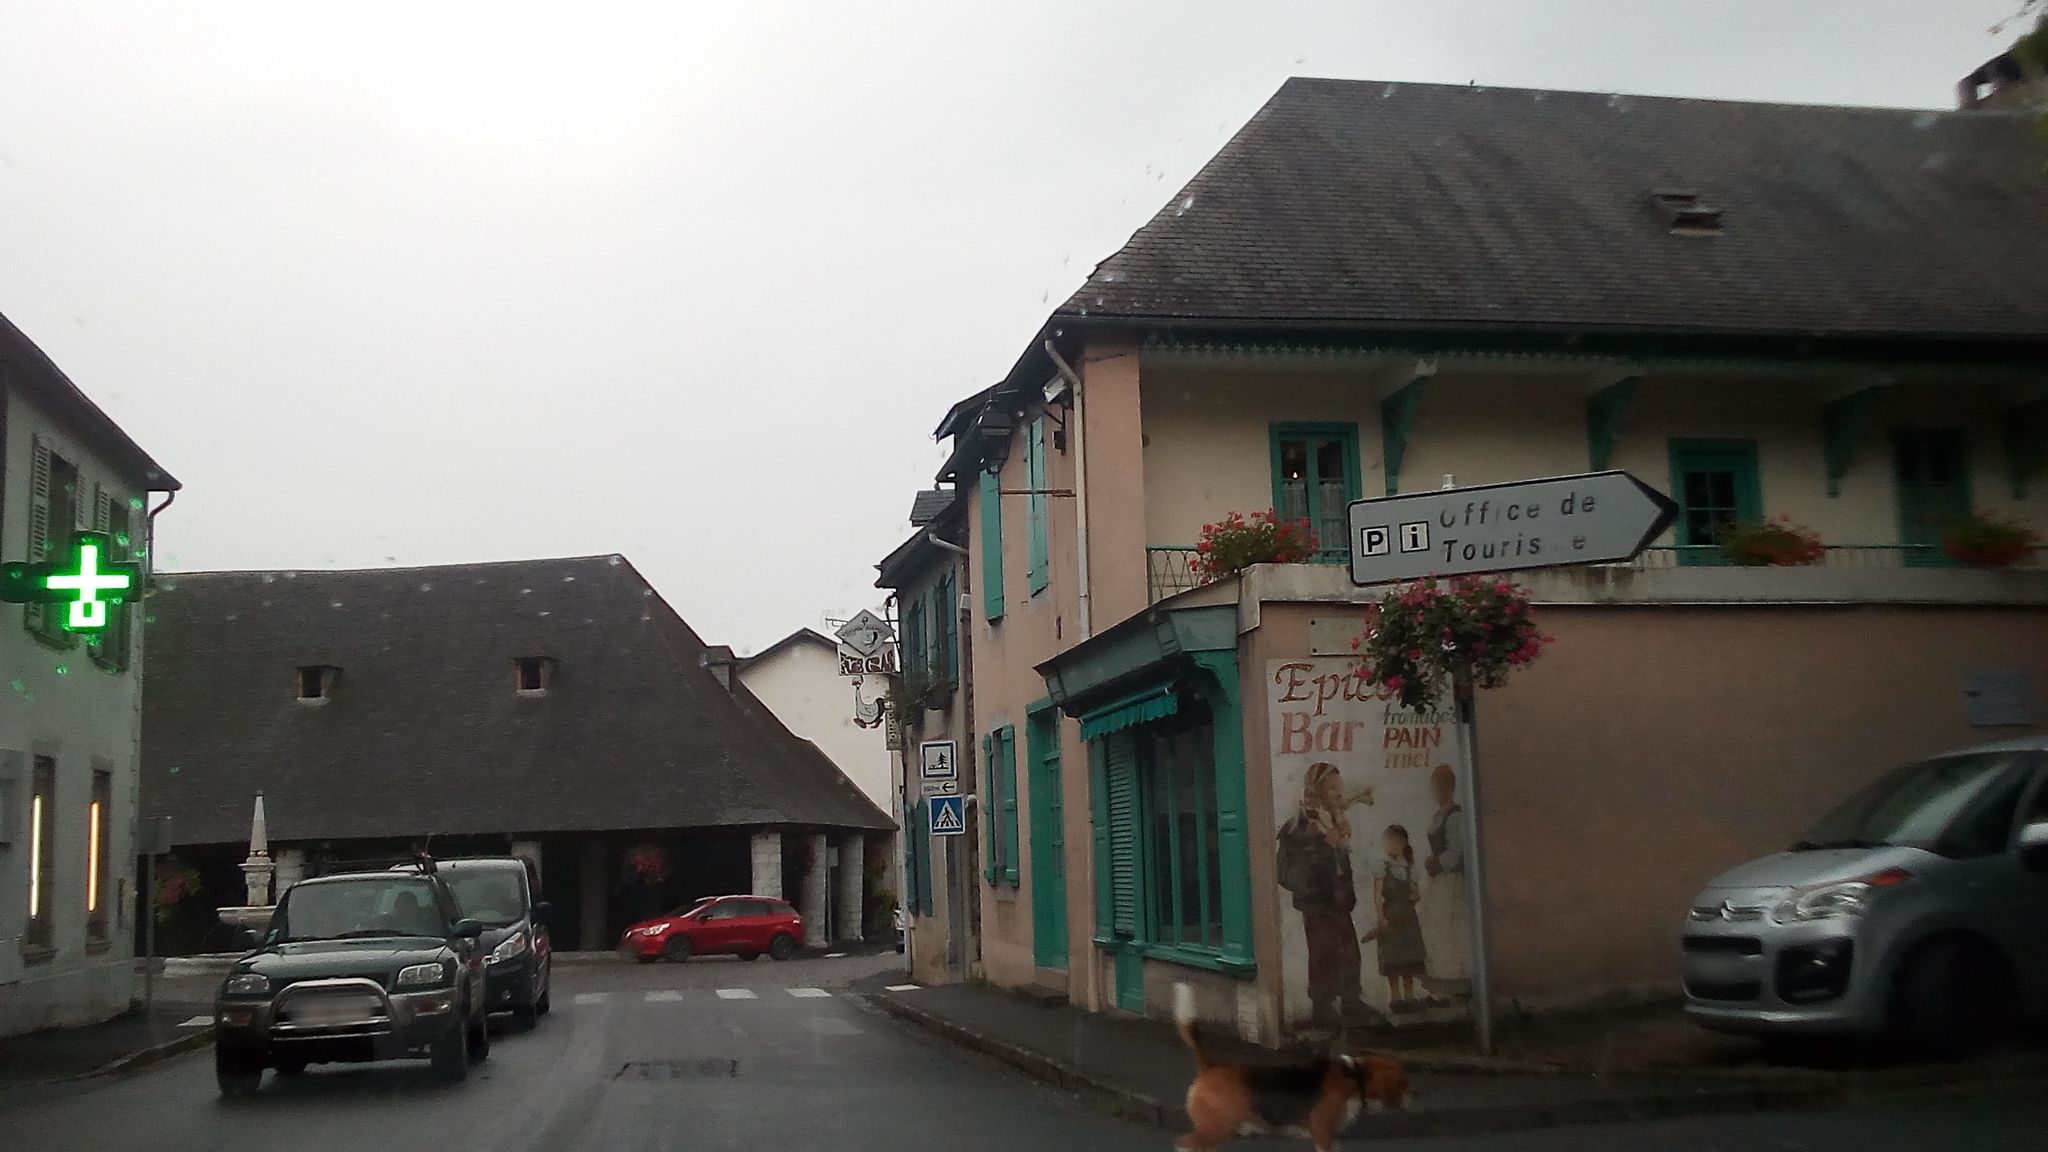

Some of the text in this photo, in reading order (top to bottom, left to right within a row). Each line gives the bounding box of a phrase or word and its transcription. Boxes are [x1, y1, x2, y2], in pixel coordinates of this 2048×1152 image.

[1560, 491, 1596, 516] de
[1366, 529, 1384, 553] P
[1442, 532, 1587, 563] Tourise
[1280, 711, 1365, 755] Bar
[1383, 727, 1441, 749] PAIN
